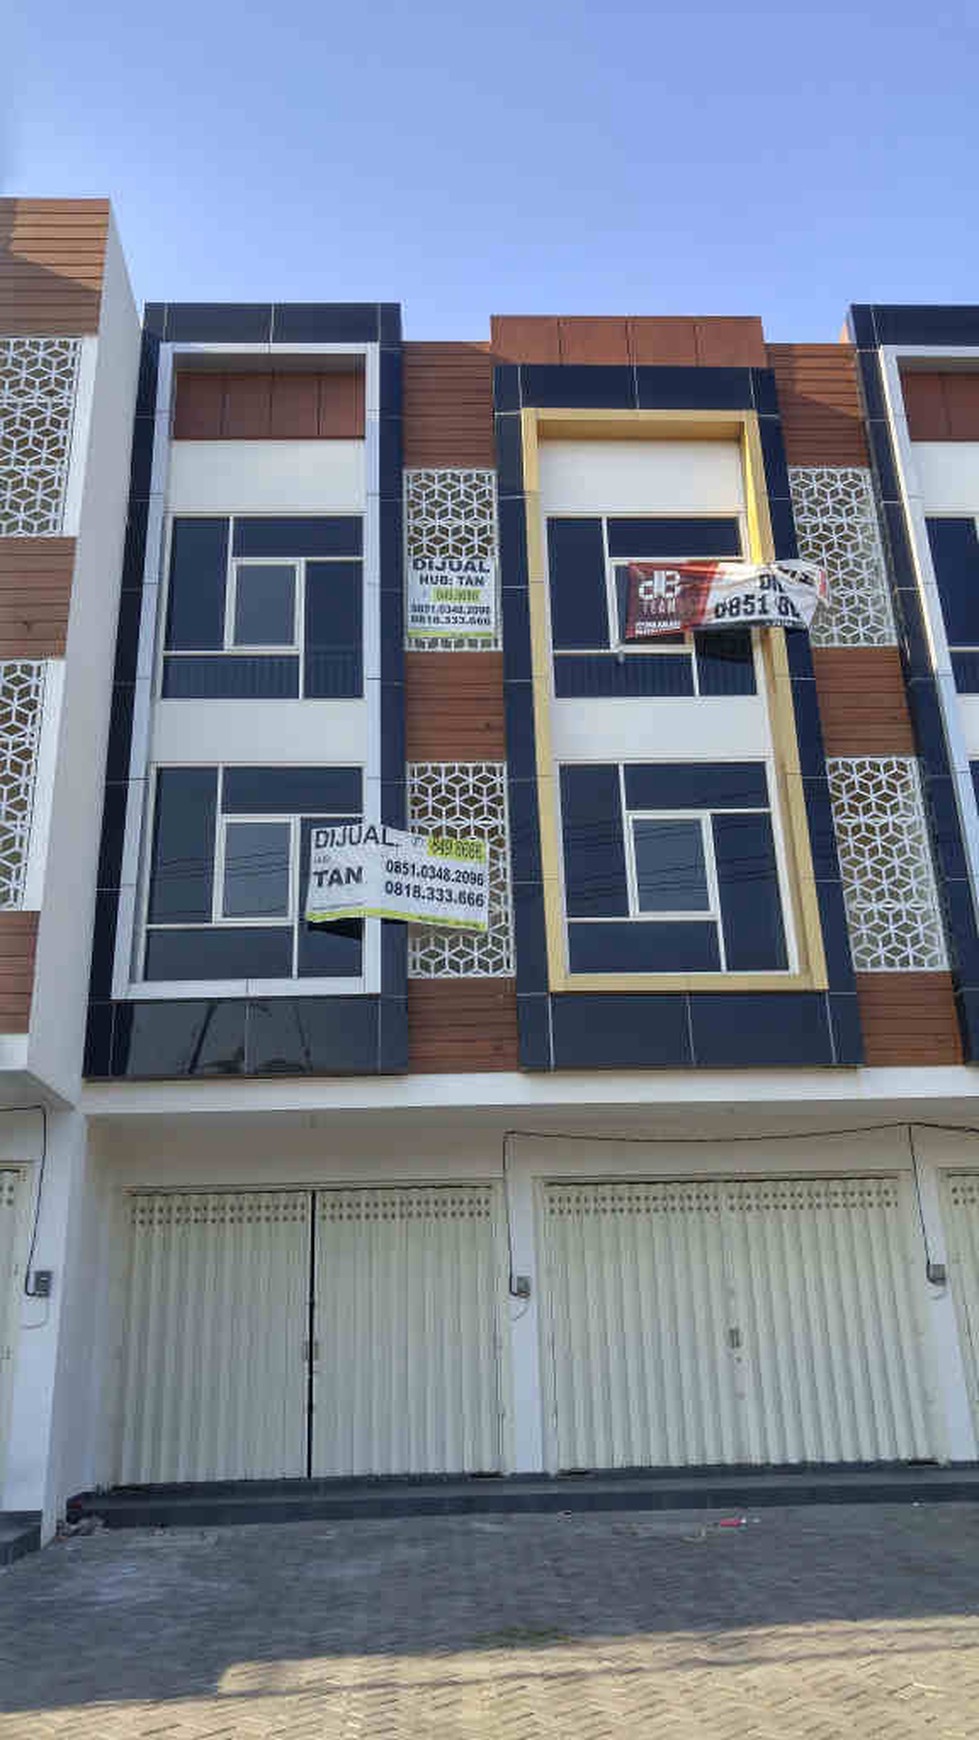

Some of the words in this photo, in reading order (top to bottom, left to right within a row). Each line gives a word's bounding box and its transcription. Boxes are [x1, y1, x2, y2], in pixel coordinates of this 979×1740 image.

[457, 575, 485, 587] TAN
[313, 866, 363, 888] TAN
[385, 859, 484, 887] 0851.0348.2096
[385, 880, 485, 908] 0818.333.666
